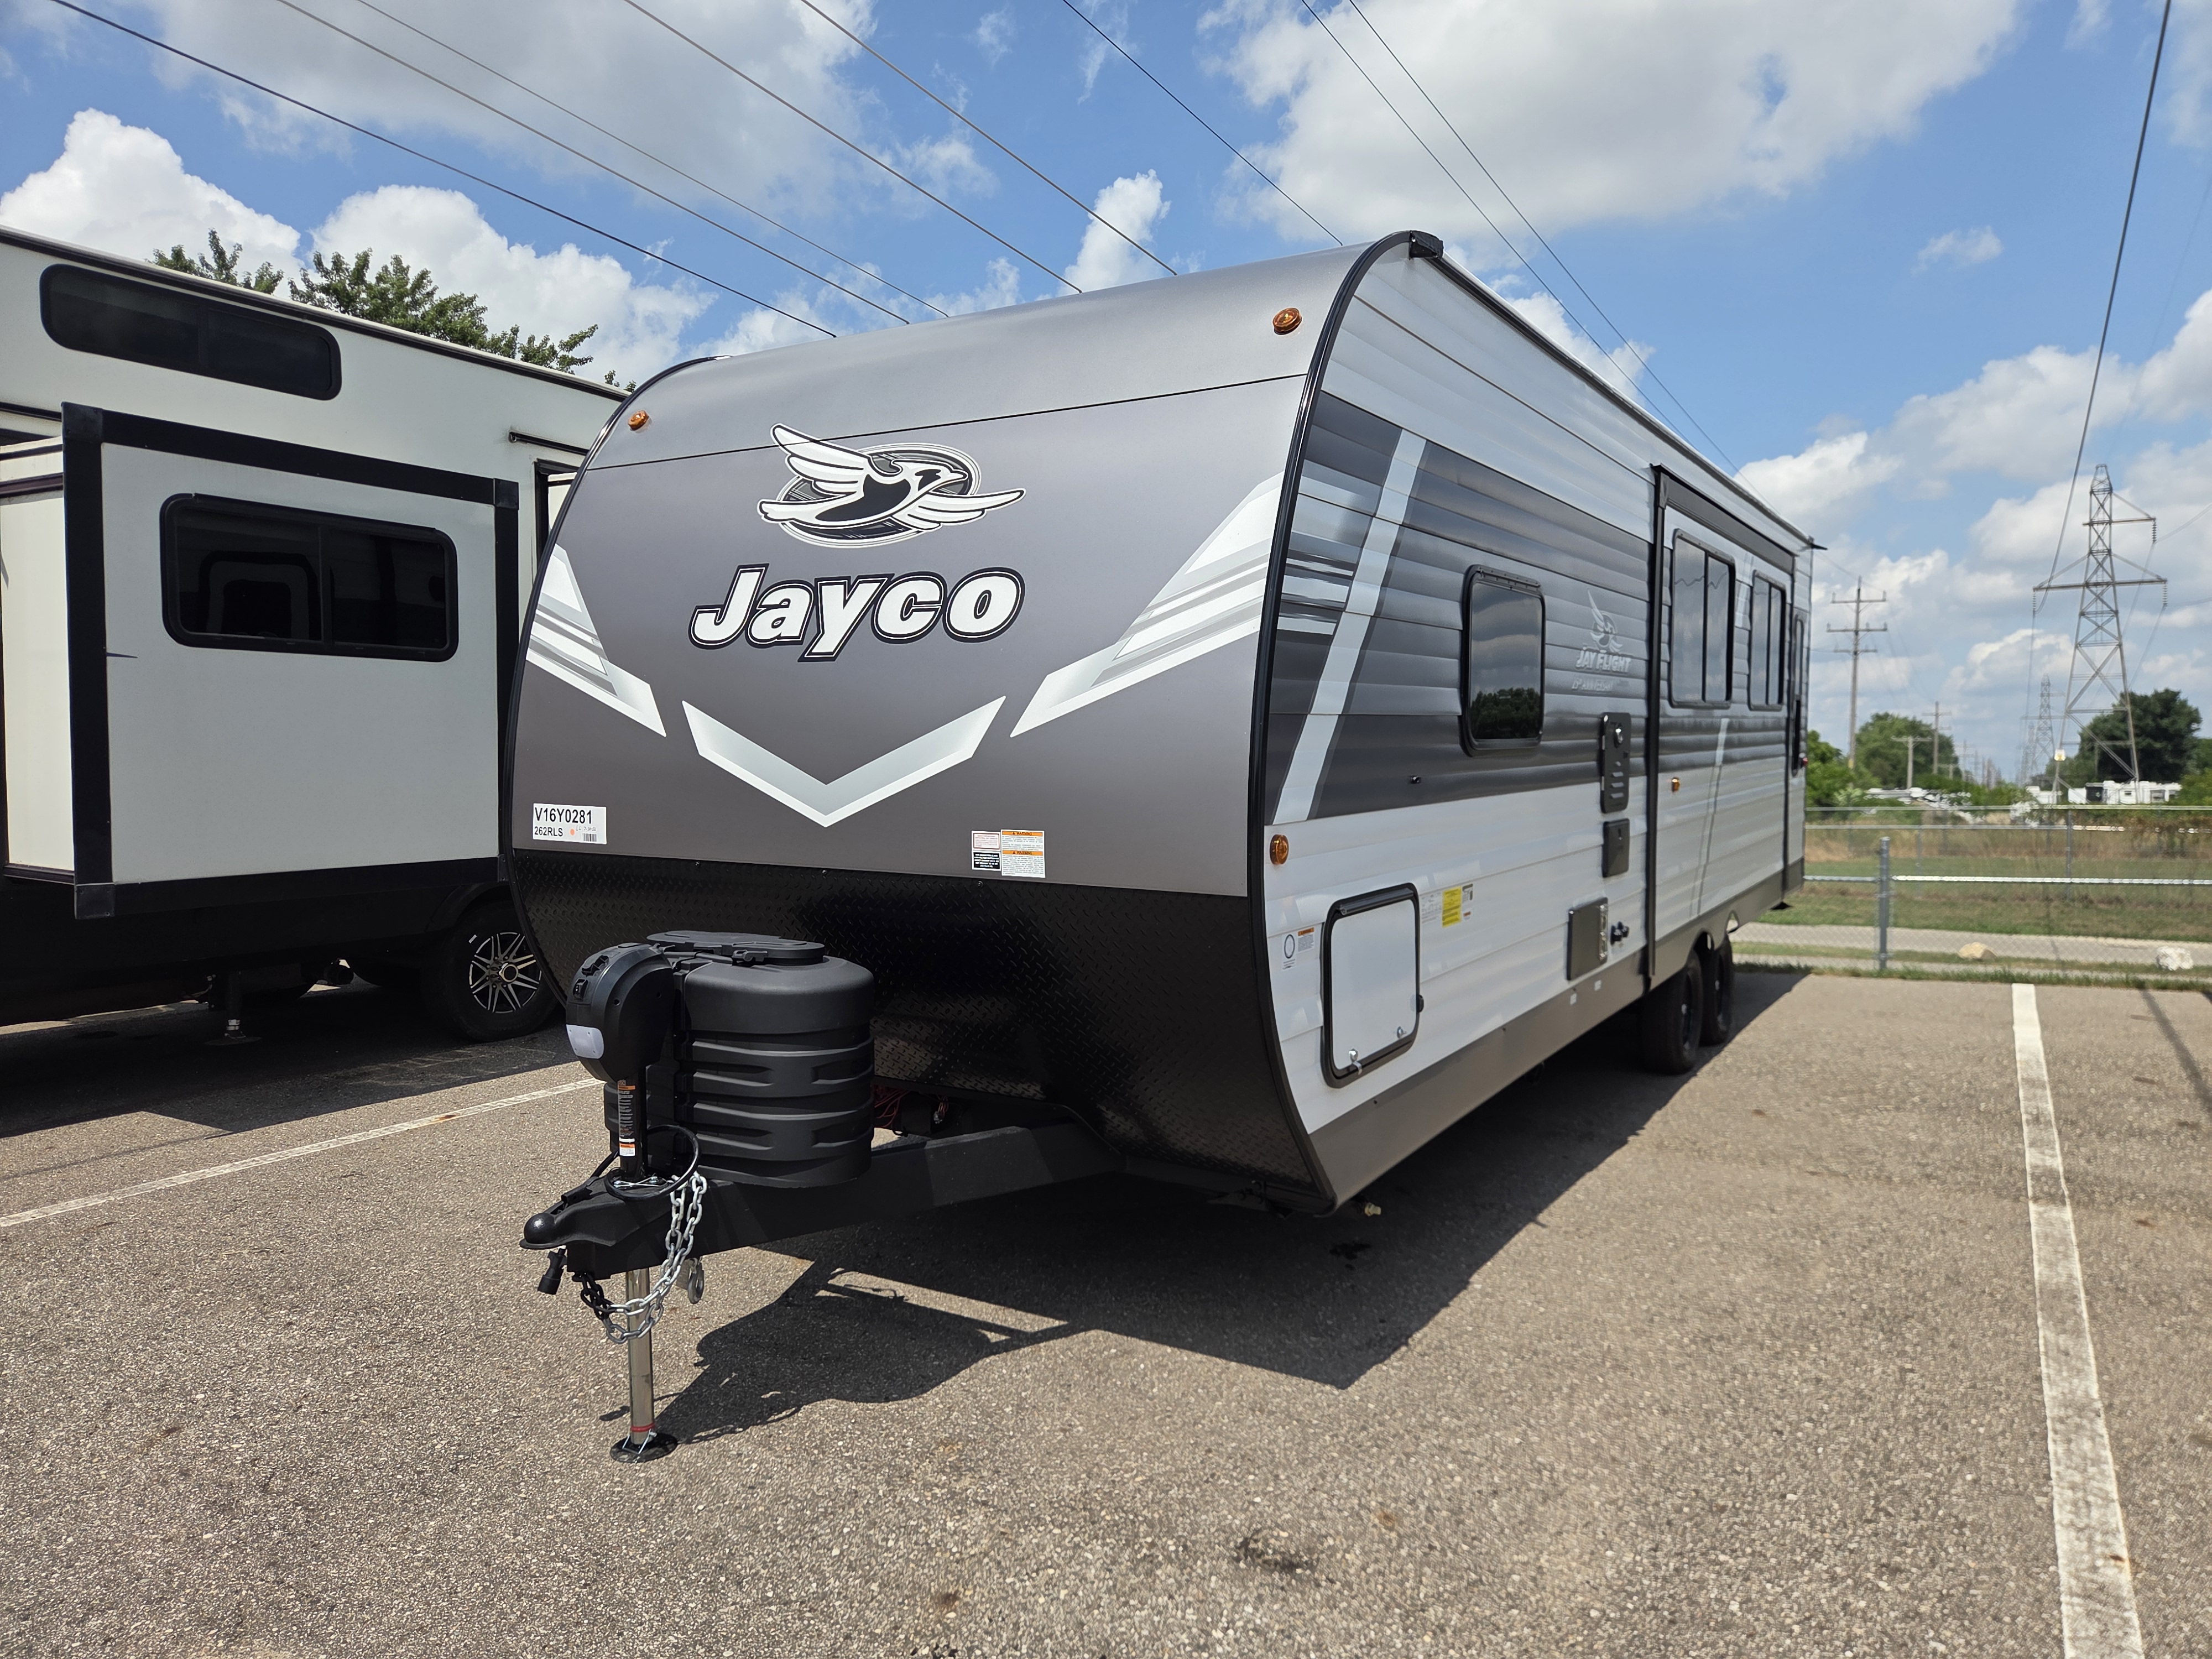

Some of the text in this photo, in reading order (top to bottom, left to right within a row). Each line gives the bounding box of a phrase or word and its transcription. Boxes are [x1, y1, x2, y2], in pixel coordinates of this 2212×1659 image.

[688, 563, 1025, 662] Jayco
[1575, 648, 1631, 672] JAY FLIGHT
[535, 807, 592, 824] V16Y0281
[534, 826, 563, 837] 262RLS
